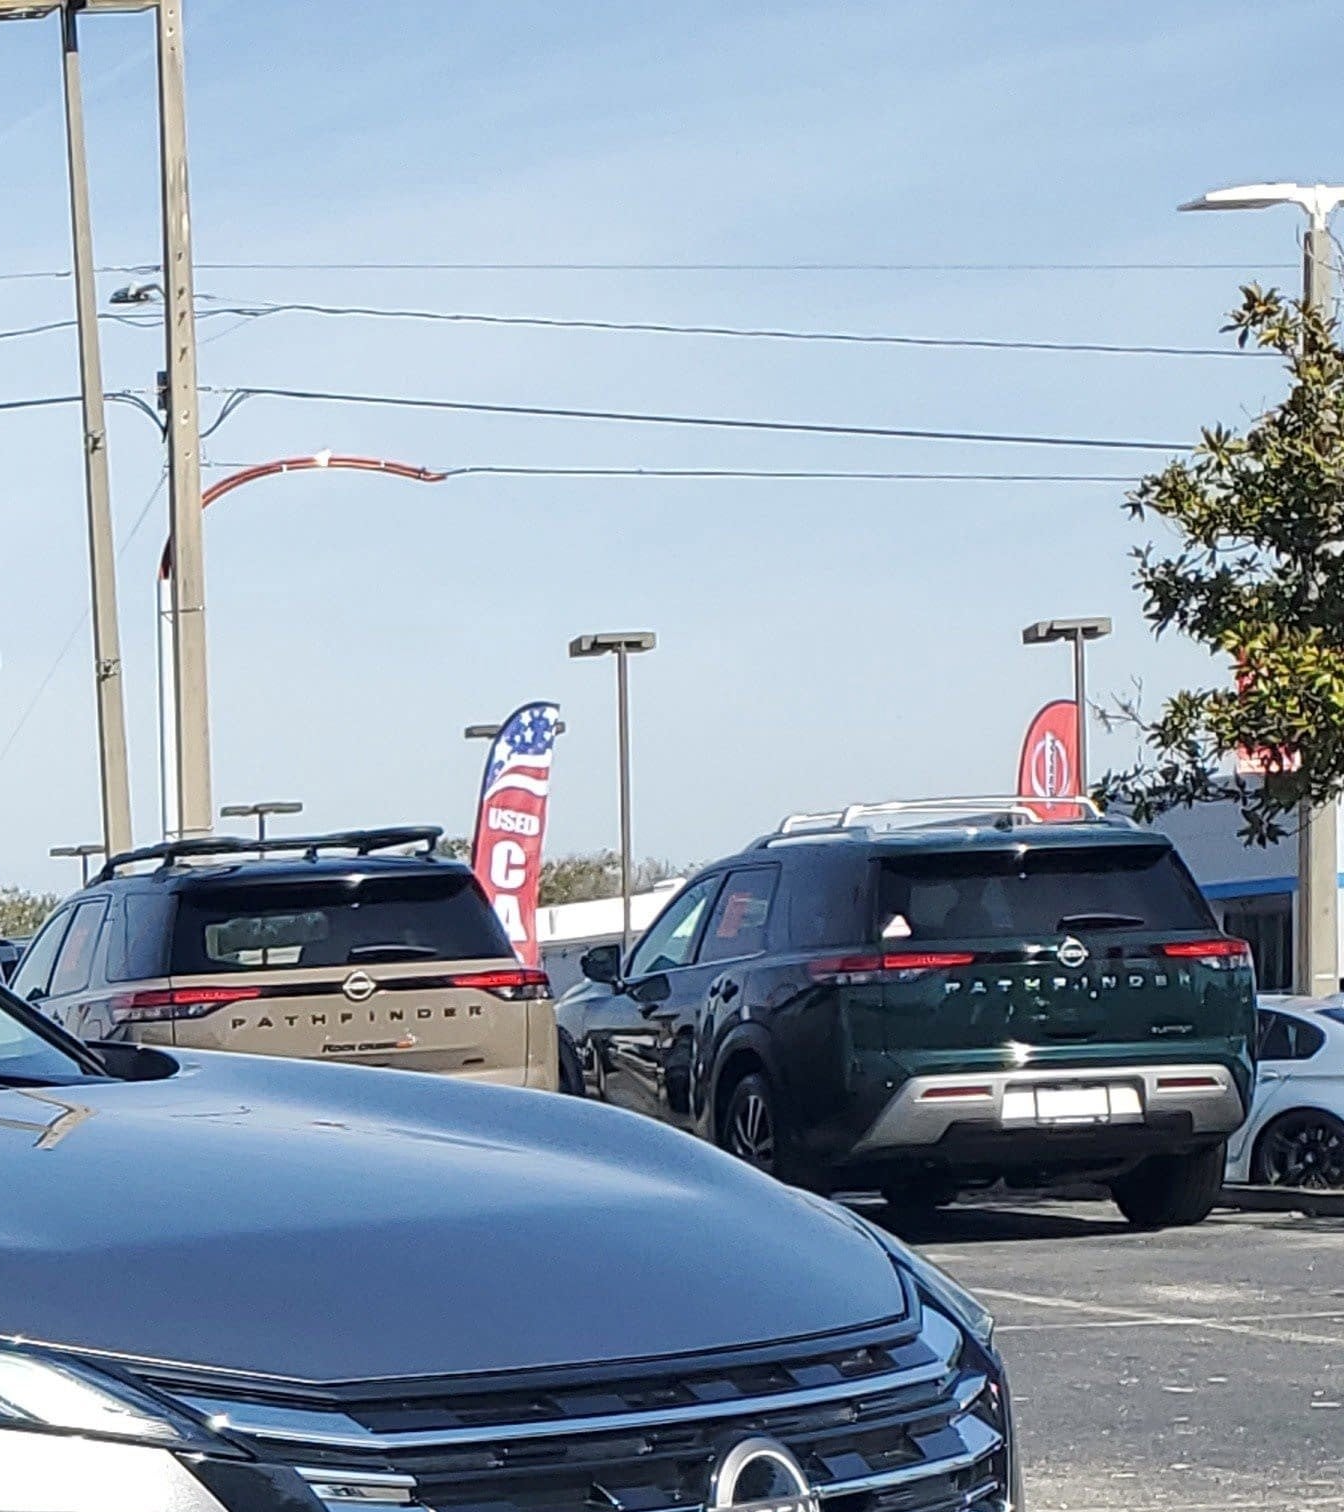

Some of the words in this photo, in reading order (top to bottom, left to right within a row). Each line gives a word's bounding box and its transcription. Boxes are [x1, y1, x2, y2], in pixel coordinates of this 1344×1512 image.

[488, 807, 541, 837] USED
[490, 840, 529, 964] CA
[944, 971, 1191, 995] PATHFINDER
[231, 1005, 483, 1029] PATHFINDER
